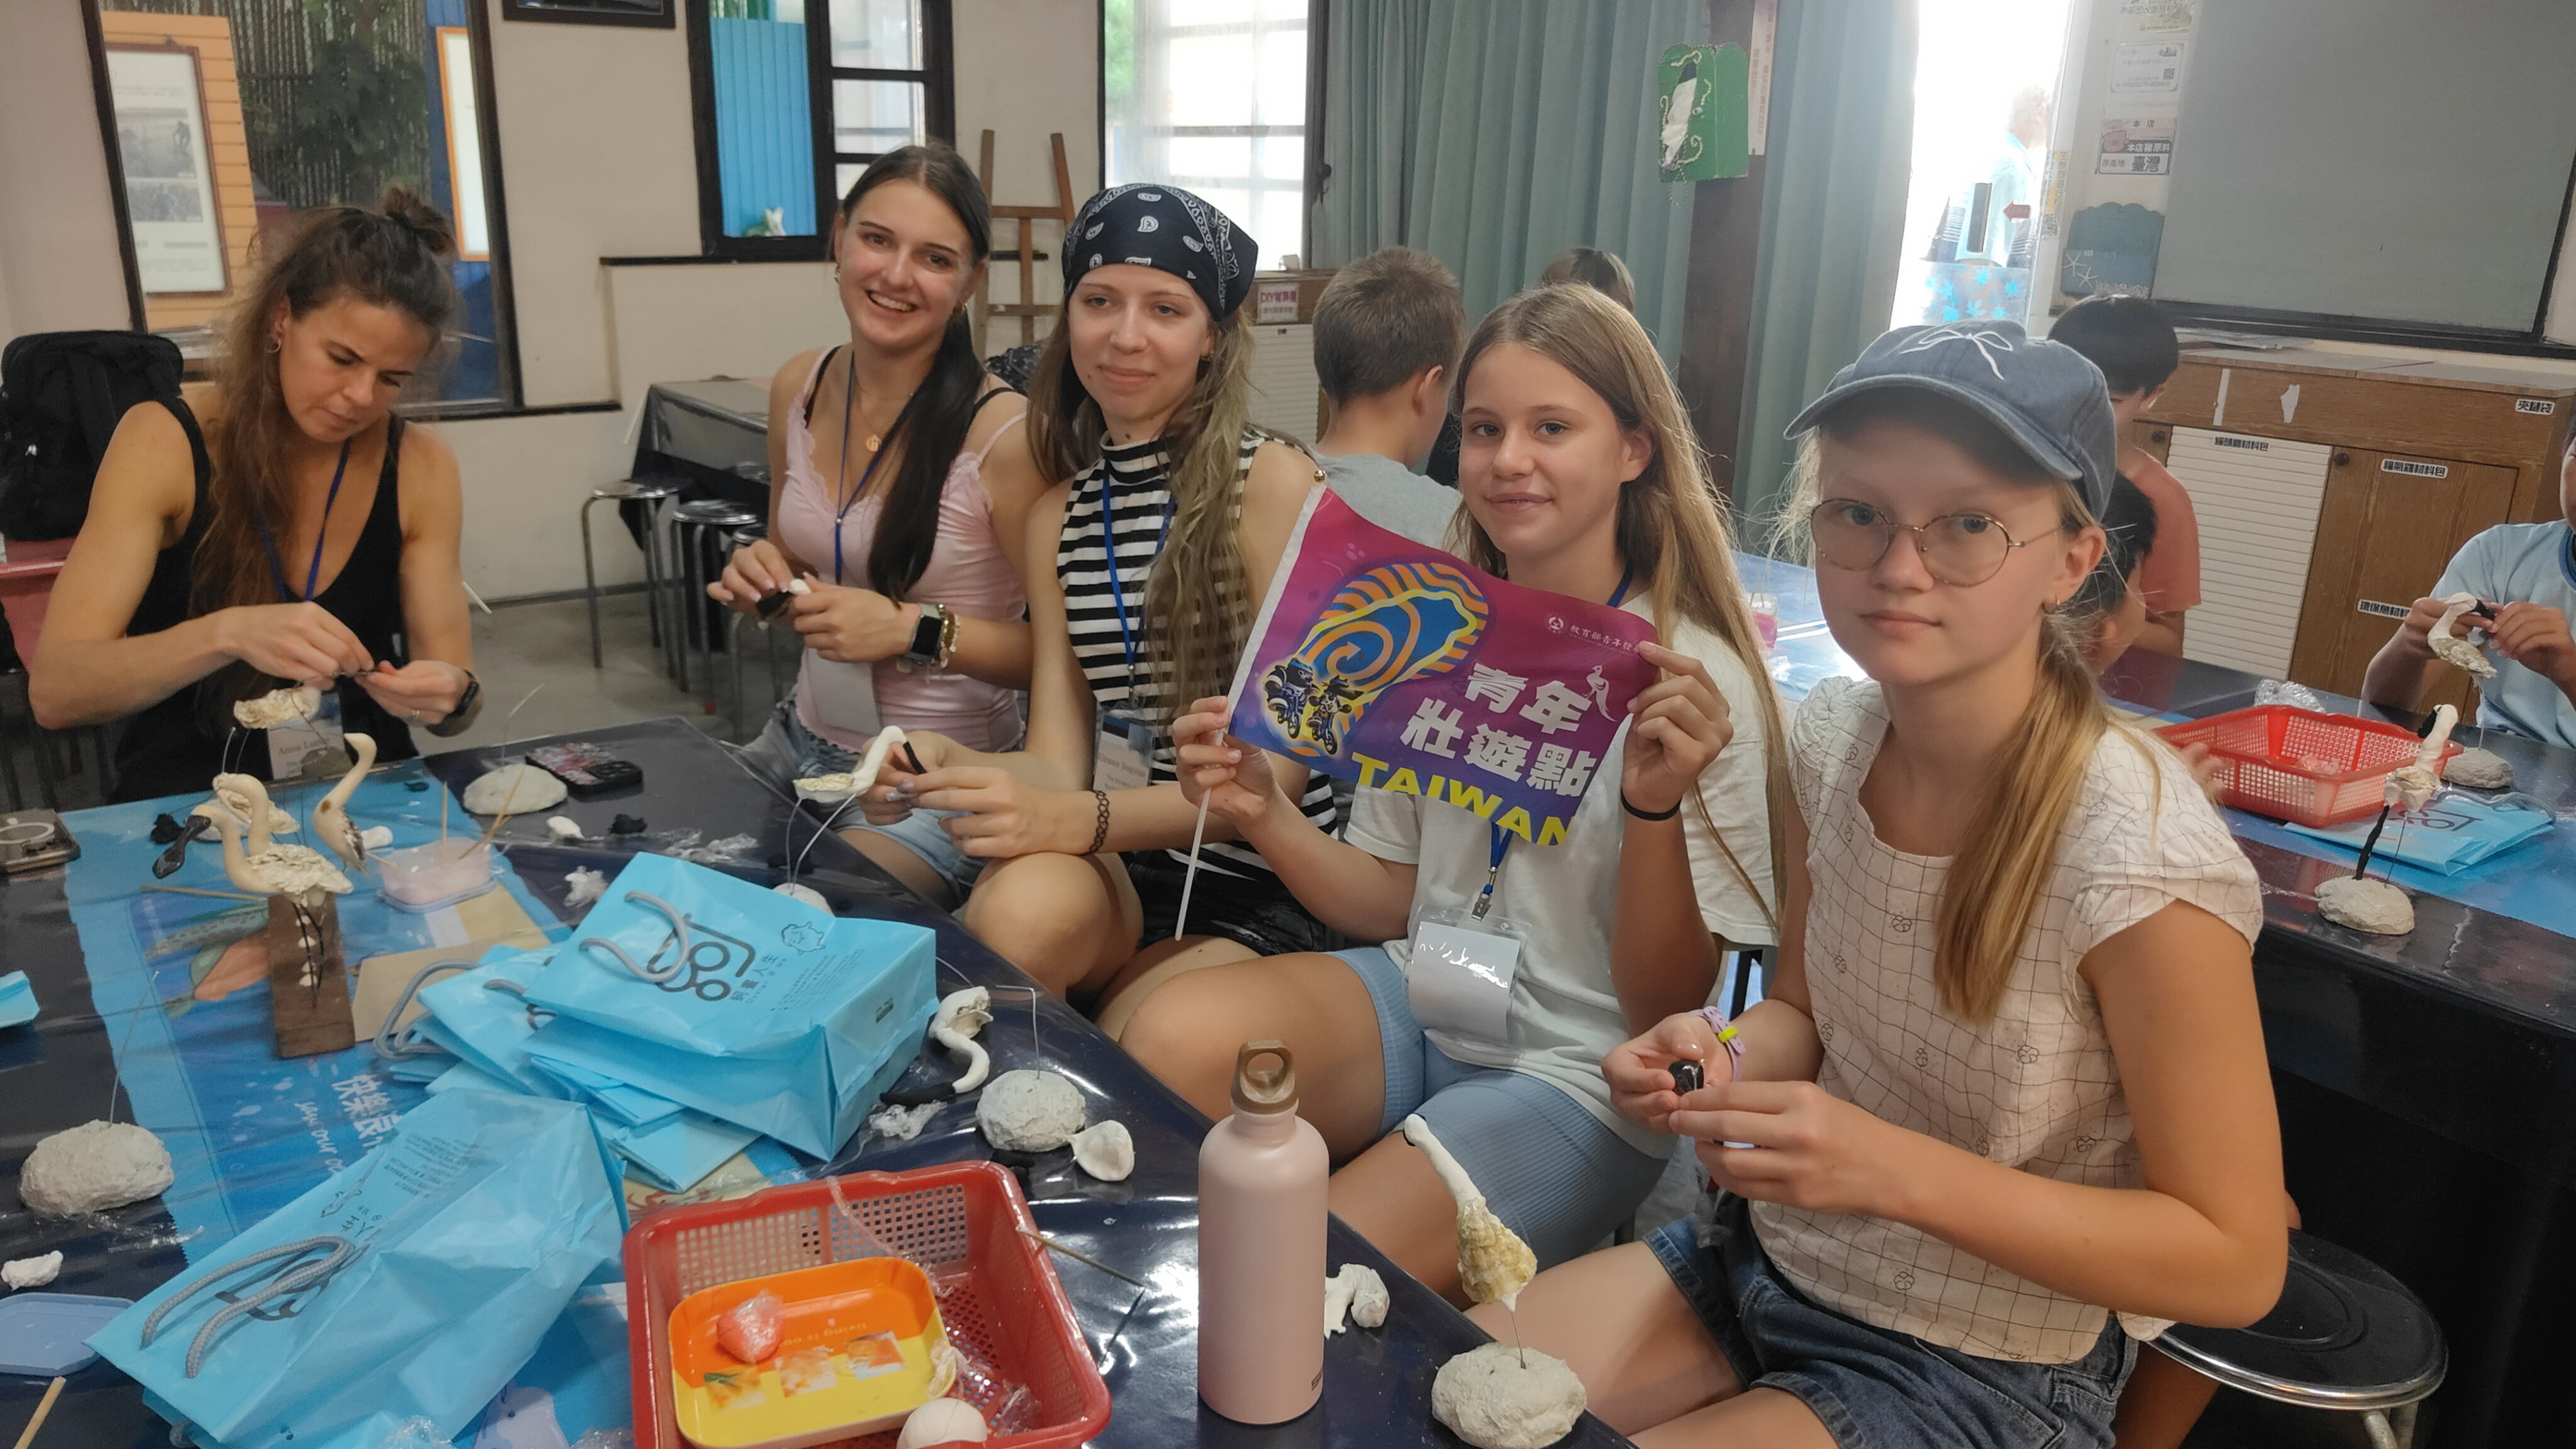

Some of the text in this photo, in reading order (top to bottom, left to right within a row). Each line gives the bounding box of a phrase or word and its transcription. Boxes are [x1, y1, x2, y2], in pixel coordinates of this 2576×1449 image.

[2131, 155, 2160, 173] 臺灣
[1464, 663, 1592, 735] 青年
[1400, 697, 1597, 798] 壯遊點
[1351, 751, 1574, 846] TAIWAN
